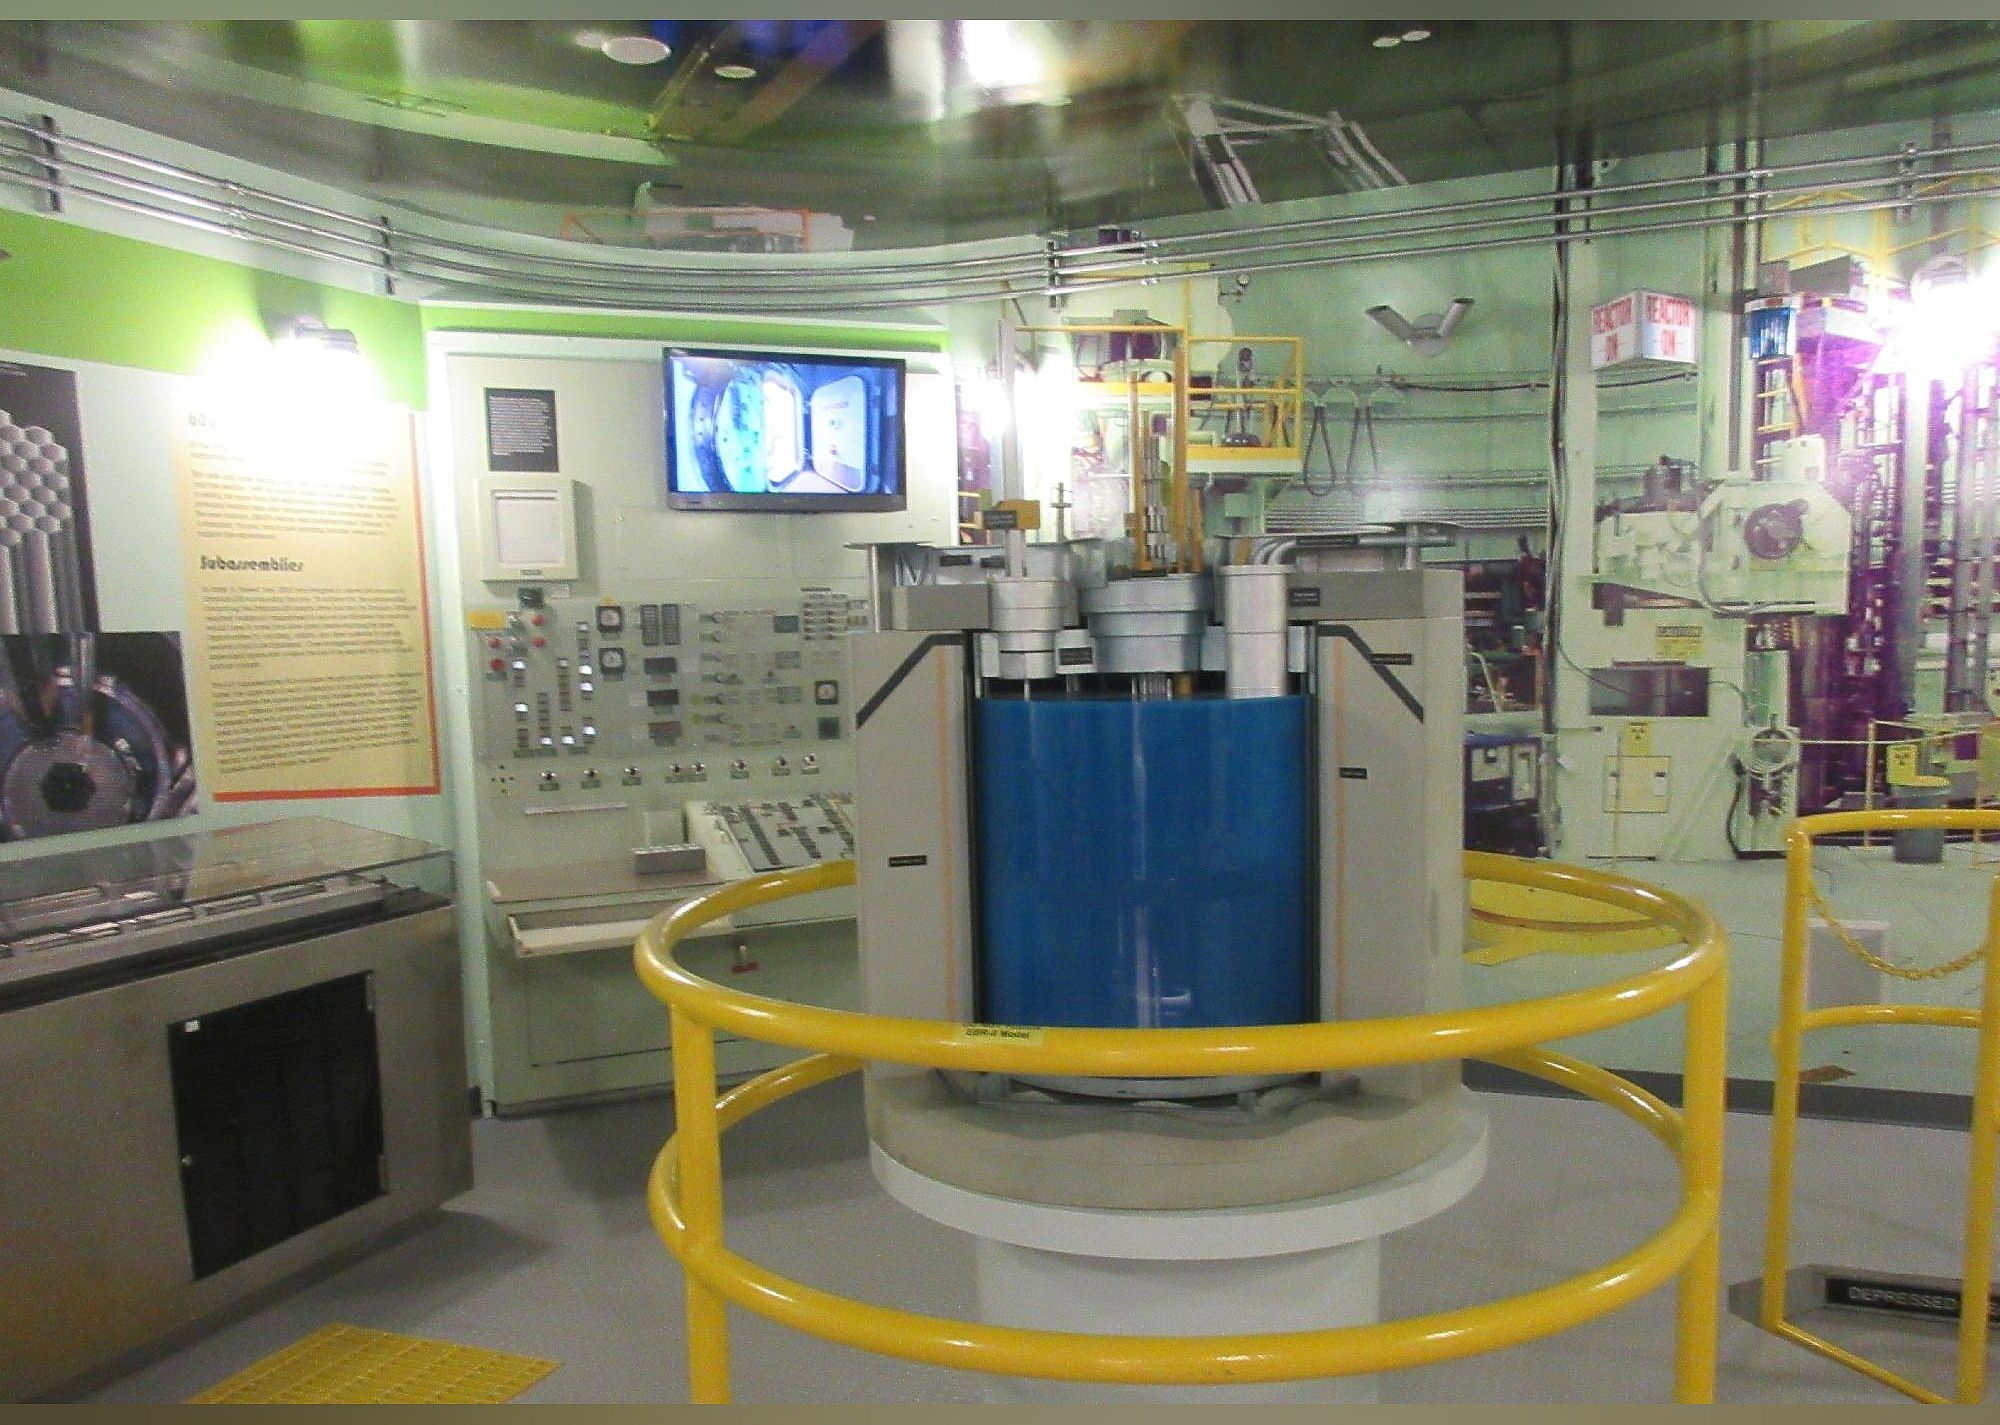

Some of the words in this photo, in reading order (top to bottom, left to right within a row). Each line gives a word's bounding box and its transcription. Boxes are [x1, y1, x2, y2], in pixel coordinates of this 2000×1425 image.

[200, 554, 304, 572] Subassemblies
[1002, 1030, 1030, 1039] Model
[1848, 1286, 1956, 1310] DEPRESSED
